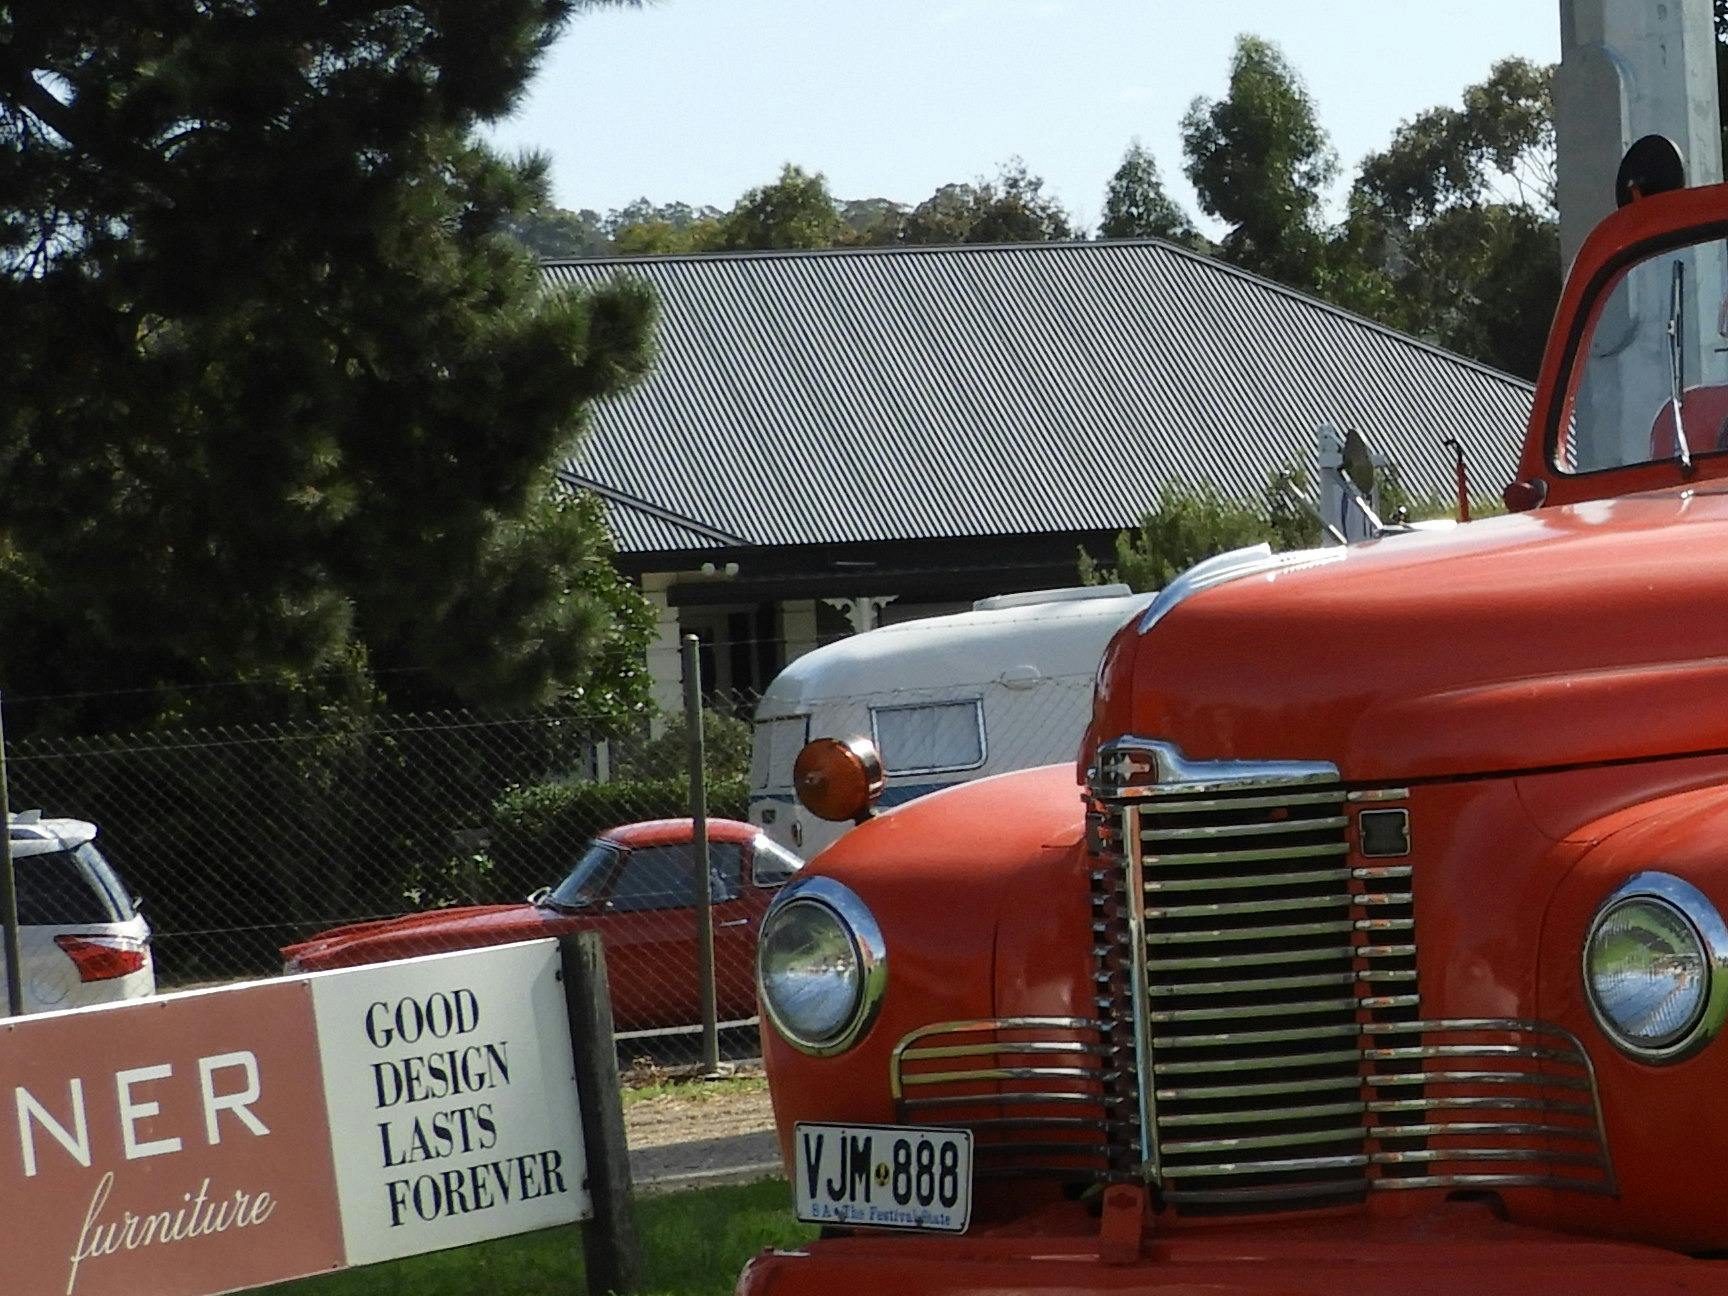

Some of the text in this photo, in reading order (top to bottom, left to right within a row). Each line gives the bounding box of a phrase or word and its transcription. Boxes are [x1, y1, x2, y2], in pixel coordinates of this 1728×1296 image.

[365, 988, 480, 1049] GOOD
[371, 1040, 511, 1110] DESIGN
[15, 1050, 271, 1177] NER
[378, 1104, 497, 1168] LASTS
[386, 1150, 567, 1229] FOREVER
[67, 1171, 277, 1296] furniture
